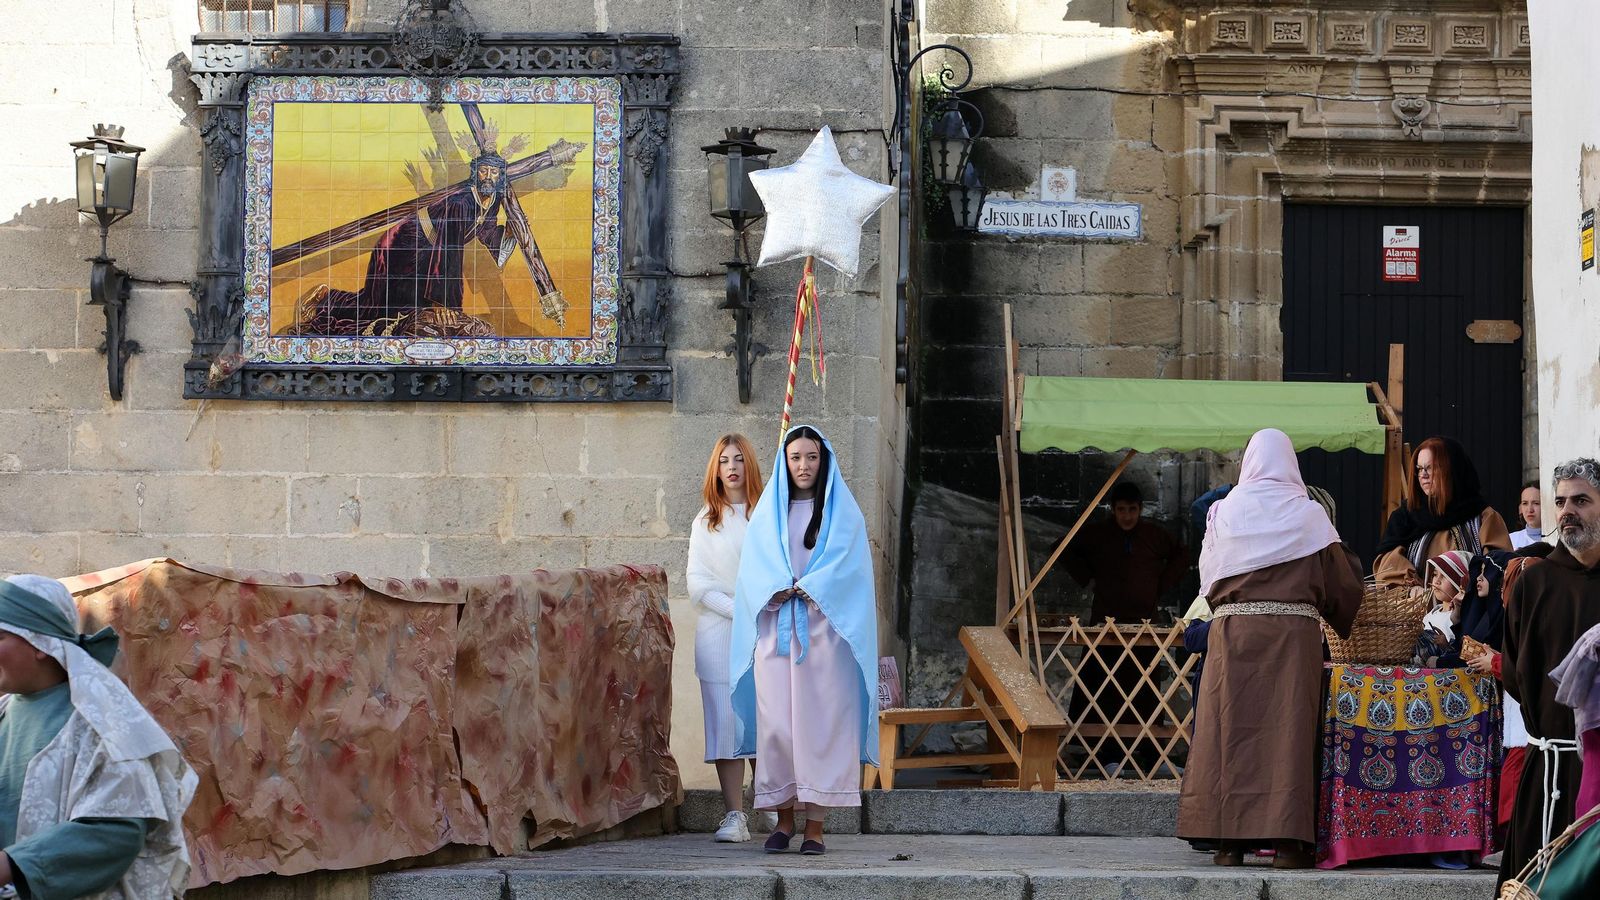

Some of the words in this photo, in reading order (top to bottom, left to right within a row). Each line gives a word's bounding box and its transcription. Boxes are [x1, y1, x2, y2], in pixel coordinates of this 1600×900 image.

[1404, 64, 1421, 74] DE
[983, 207, 1020, 227] JESUS
[1022, 212, 1035, 227] DE
[1037, 212, 1058, 228] LAS
[1060, 209, 1087, 229] TRES
[1089, 210, 1131, 230] CAIDAS
[1385, 249, 1416, 257] Alarma
